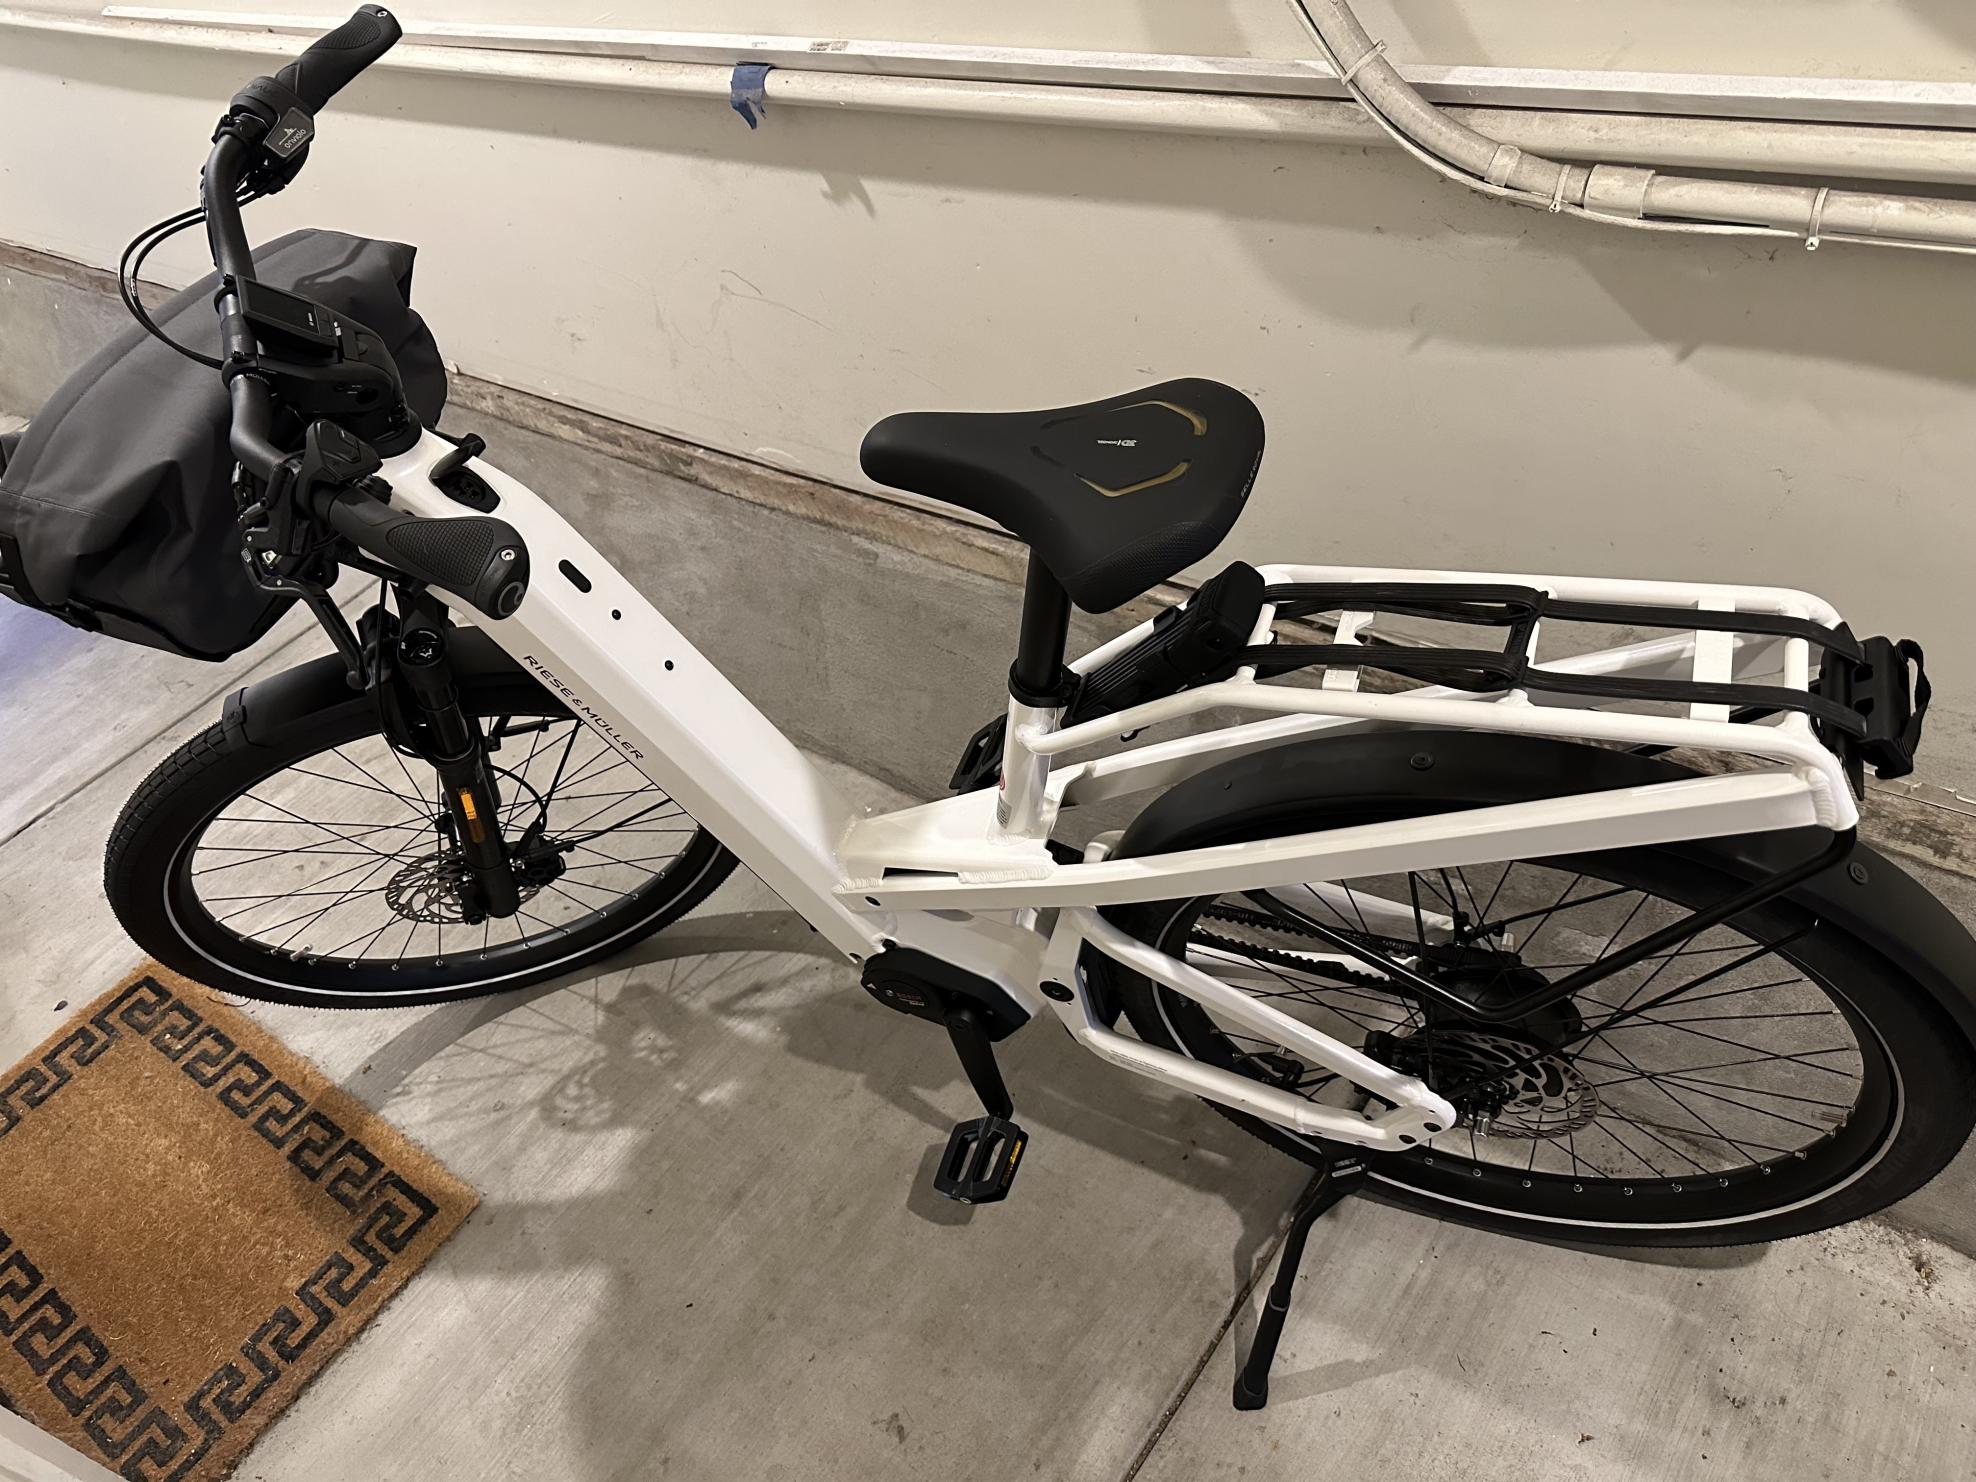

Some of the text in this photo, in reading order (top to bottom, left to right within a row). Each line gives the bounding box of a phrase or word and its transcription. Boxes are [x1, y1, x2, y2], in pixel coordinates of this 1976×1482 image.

[284, 129, 307, 149] enviolo
[523, 655, 645, 760] RIESE & MÜLLER
